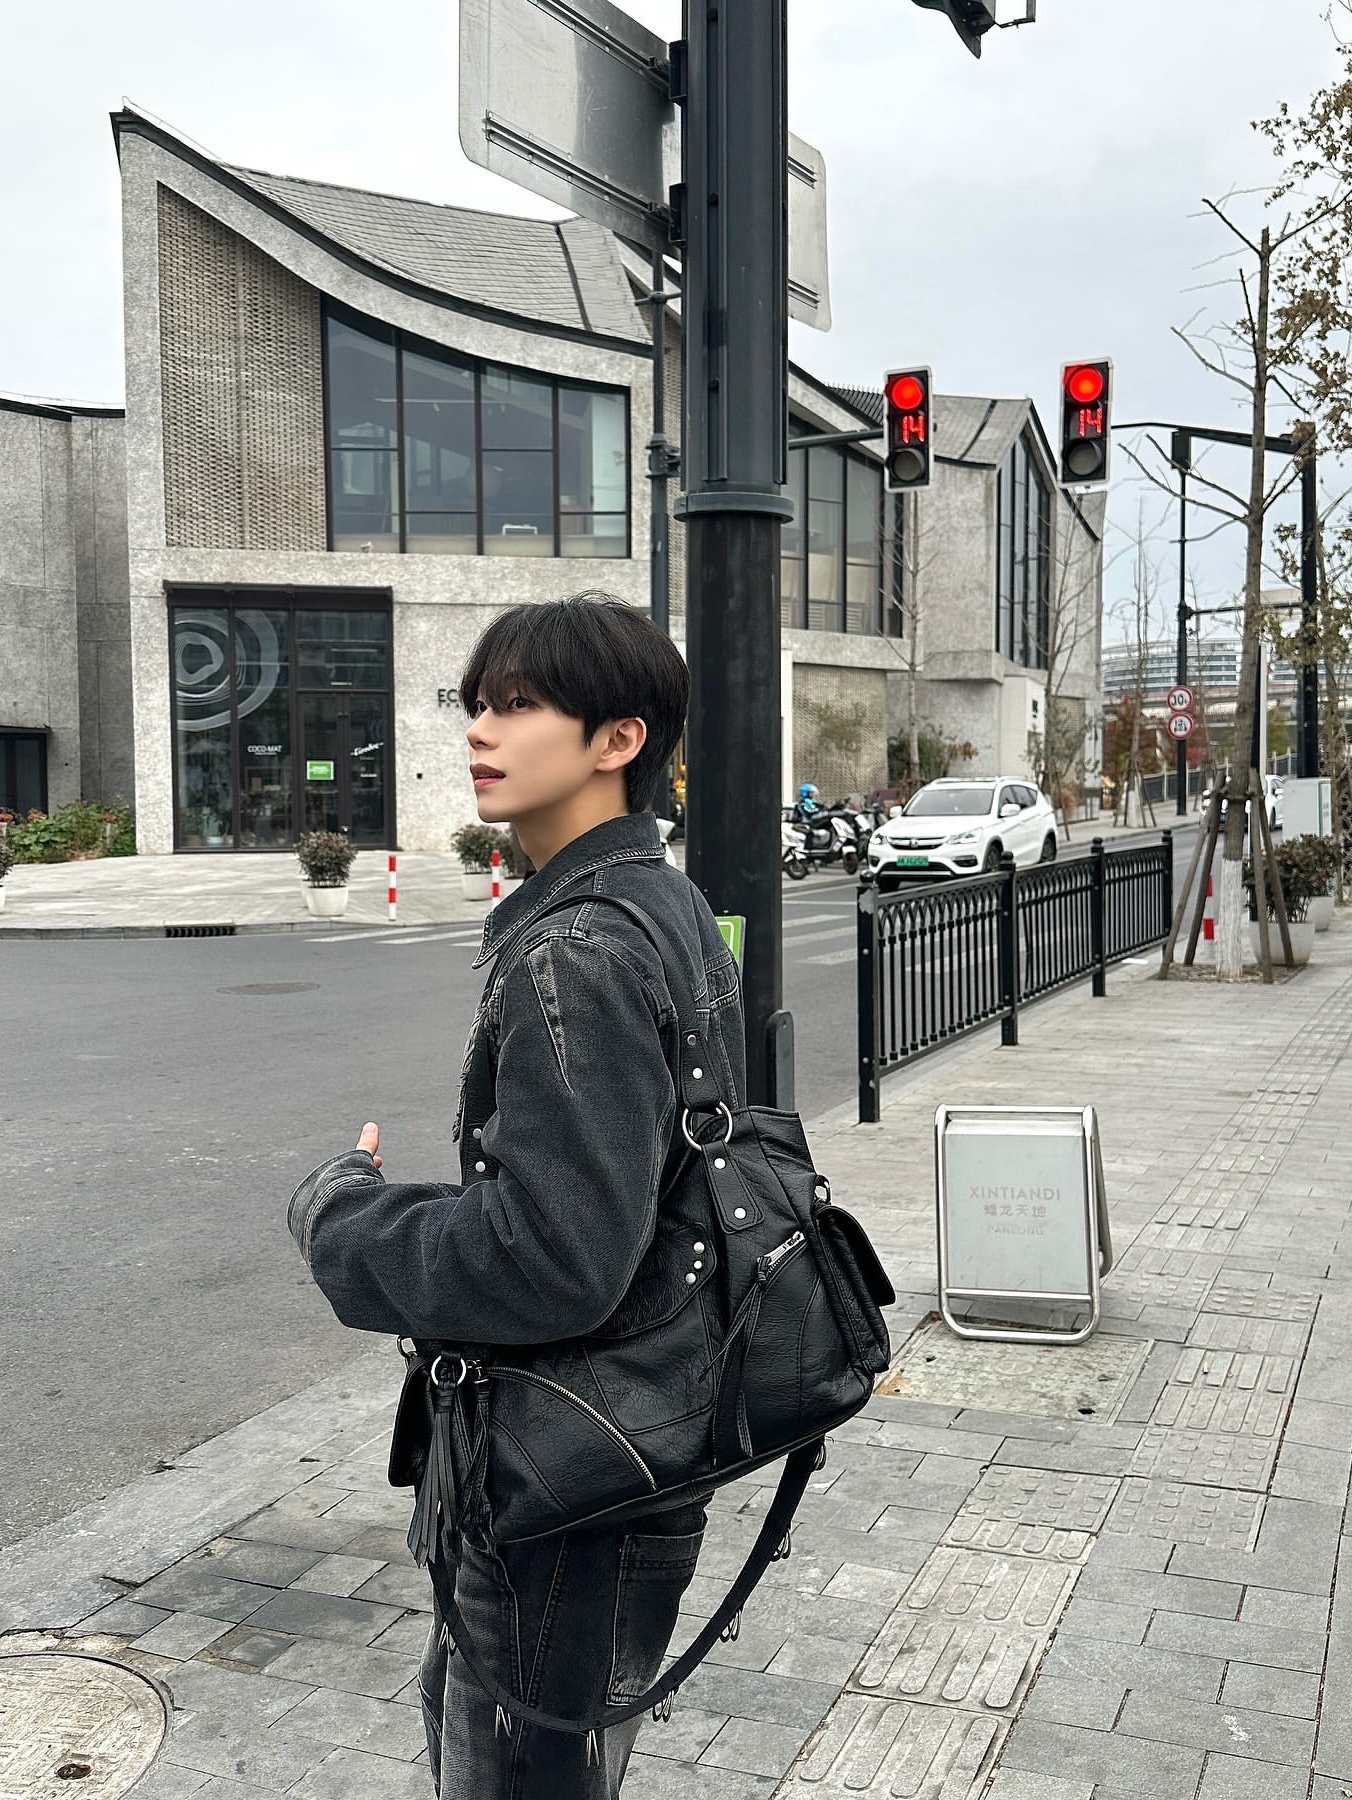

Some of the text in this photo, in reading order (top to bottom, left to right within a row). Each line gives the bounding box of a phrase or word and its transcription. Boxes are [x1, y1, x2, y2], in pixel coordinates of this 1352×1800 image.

[902, 415, 925, 444] 14
[1078, 407, 1103, 437] 14
[247, 745, 283, 753] COCO-MAT
[969, 1185, 1061, 1201] XINTIANDI
